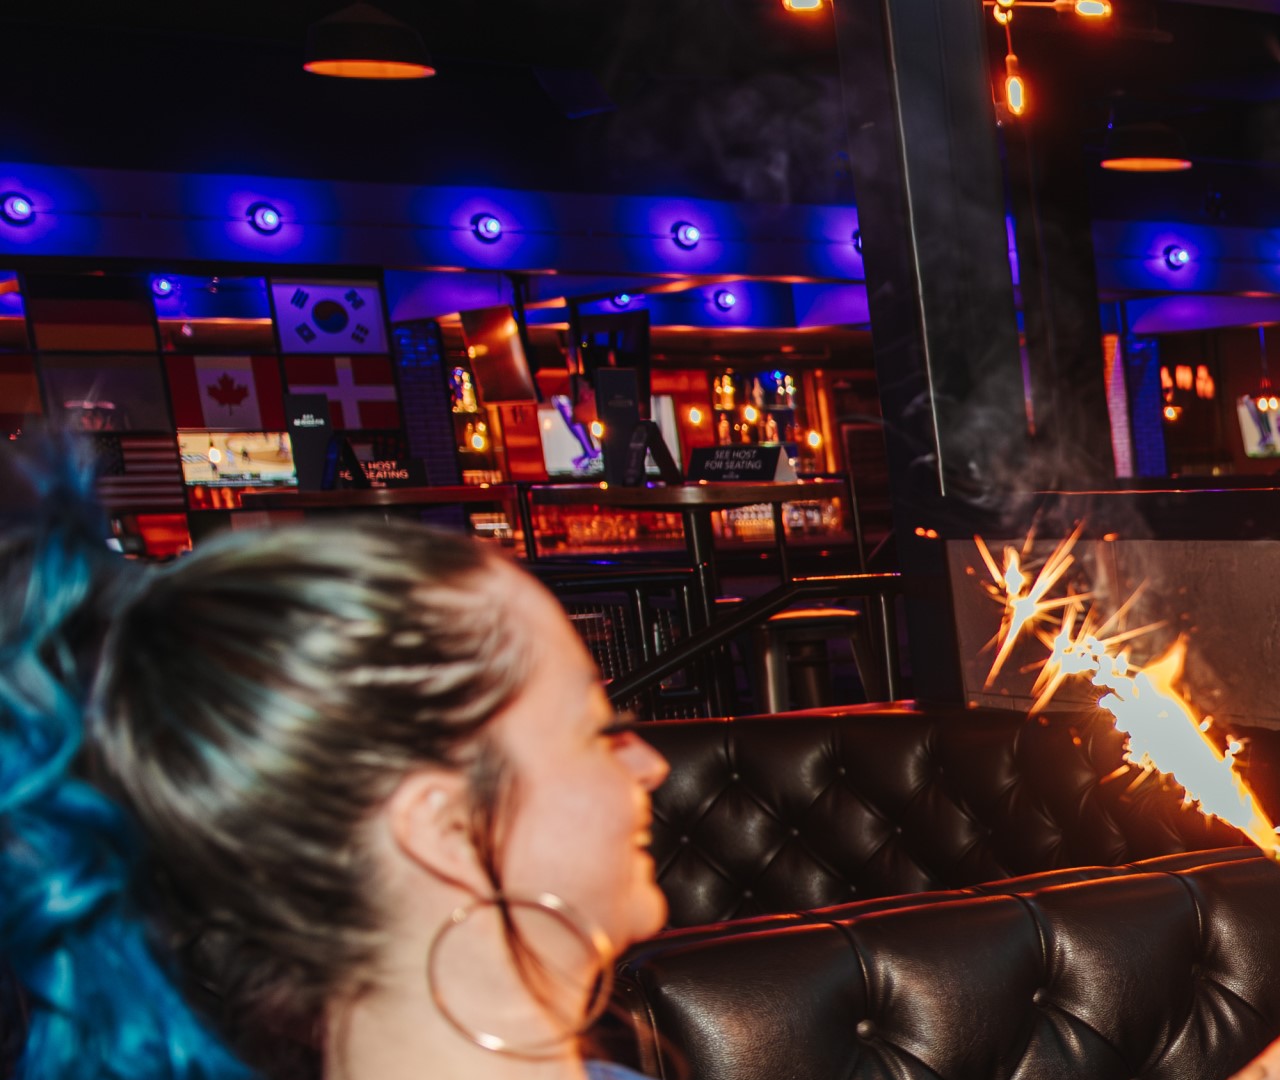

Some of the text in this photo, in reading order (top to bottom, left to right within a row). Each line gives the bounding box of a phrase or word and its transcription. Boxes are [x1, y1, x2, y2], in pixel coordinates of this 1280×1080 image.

[714, 450, 757, 459] SEE HOST
[367, 461, 397, 470] HOST
[704, 460, 762, 470] FOR SEATING
